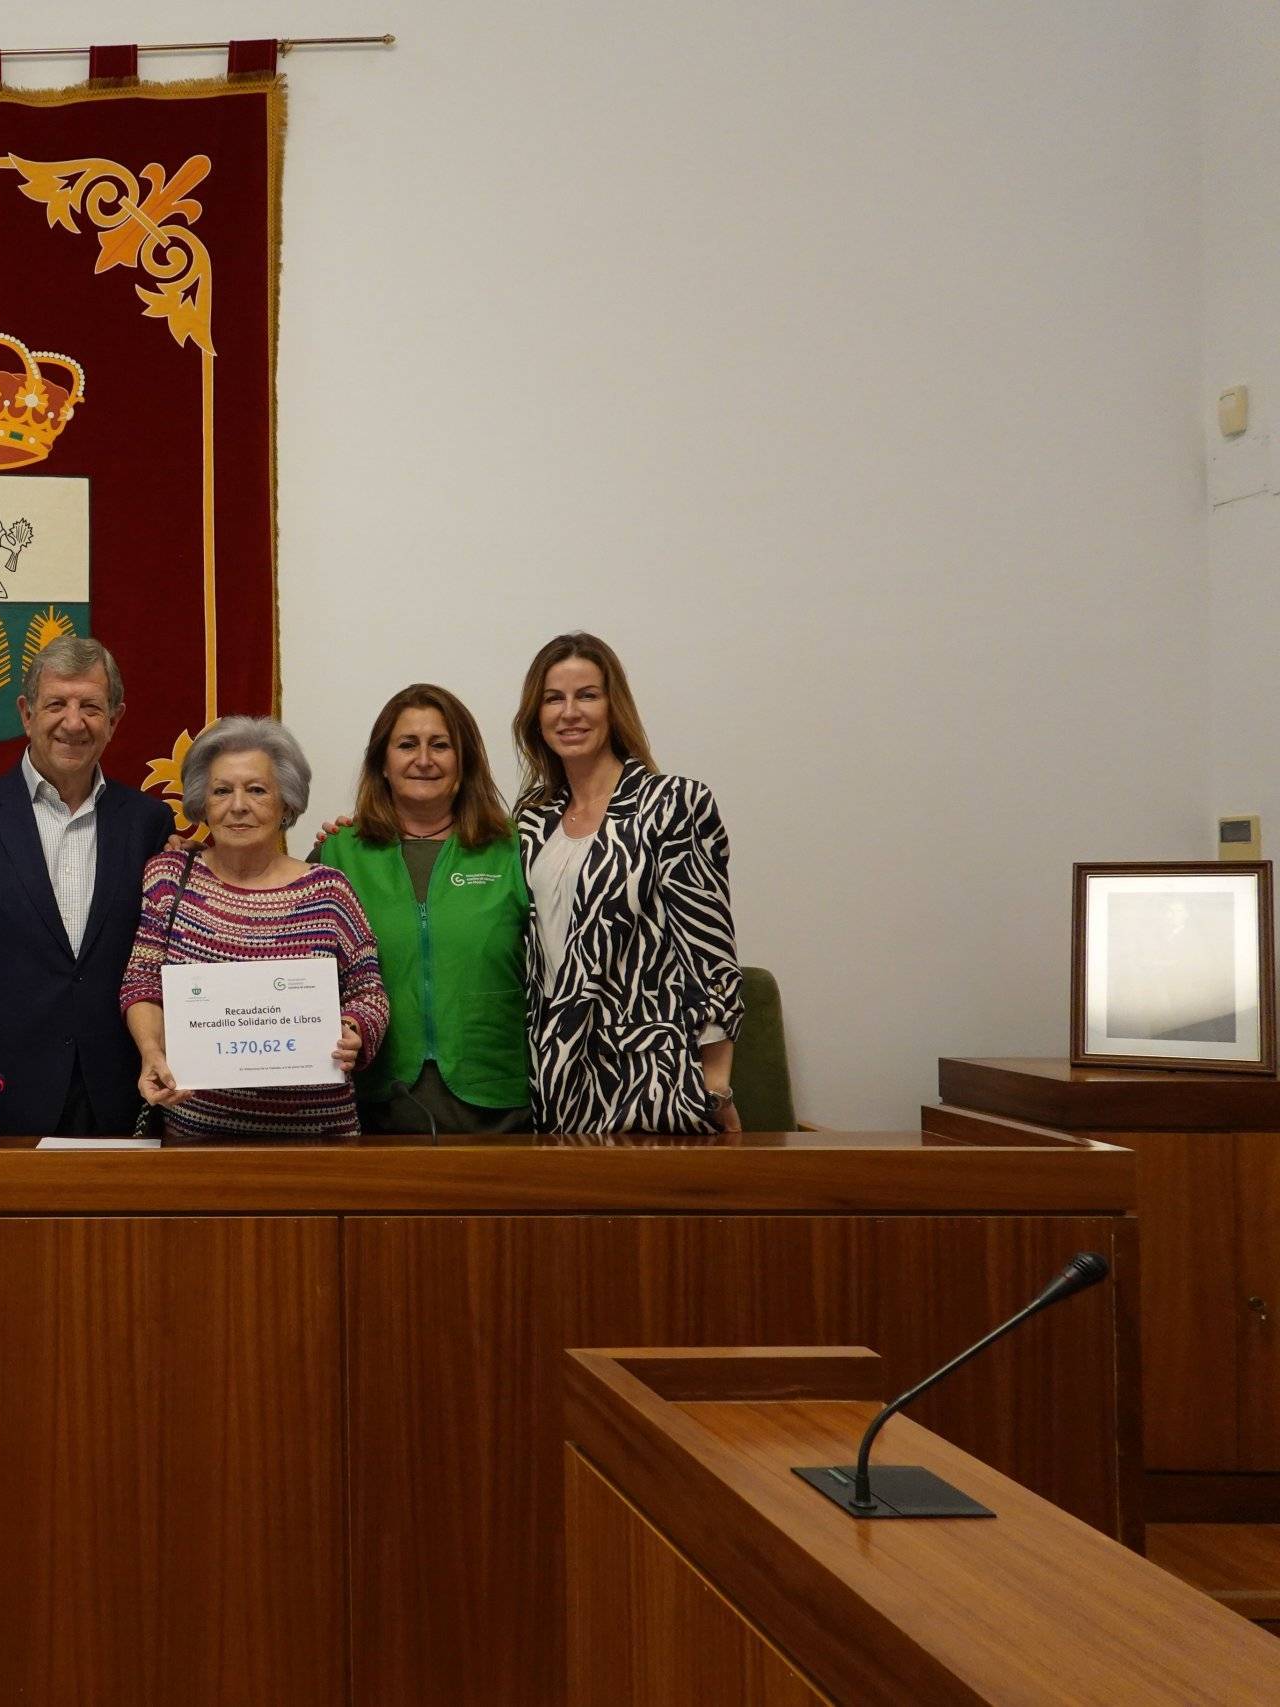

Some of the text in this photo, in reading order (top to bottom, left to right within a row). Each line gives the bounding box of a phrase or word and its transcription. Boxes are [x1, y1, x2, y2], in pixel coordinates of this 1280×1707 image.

[225, 1005, 281, 1015] Recaudación
[189, 1015, 322, 1028] Mercadillo Solidario de Libros
[216, 1039, 297, 1055] 1.370,62 €
